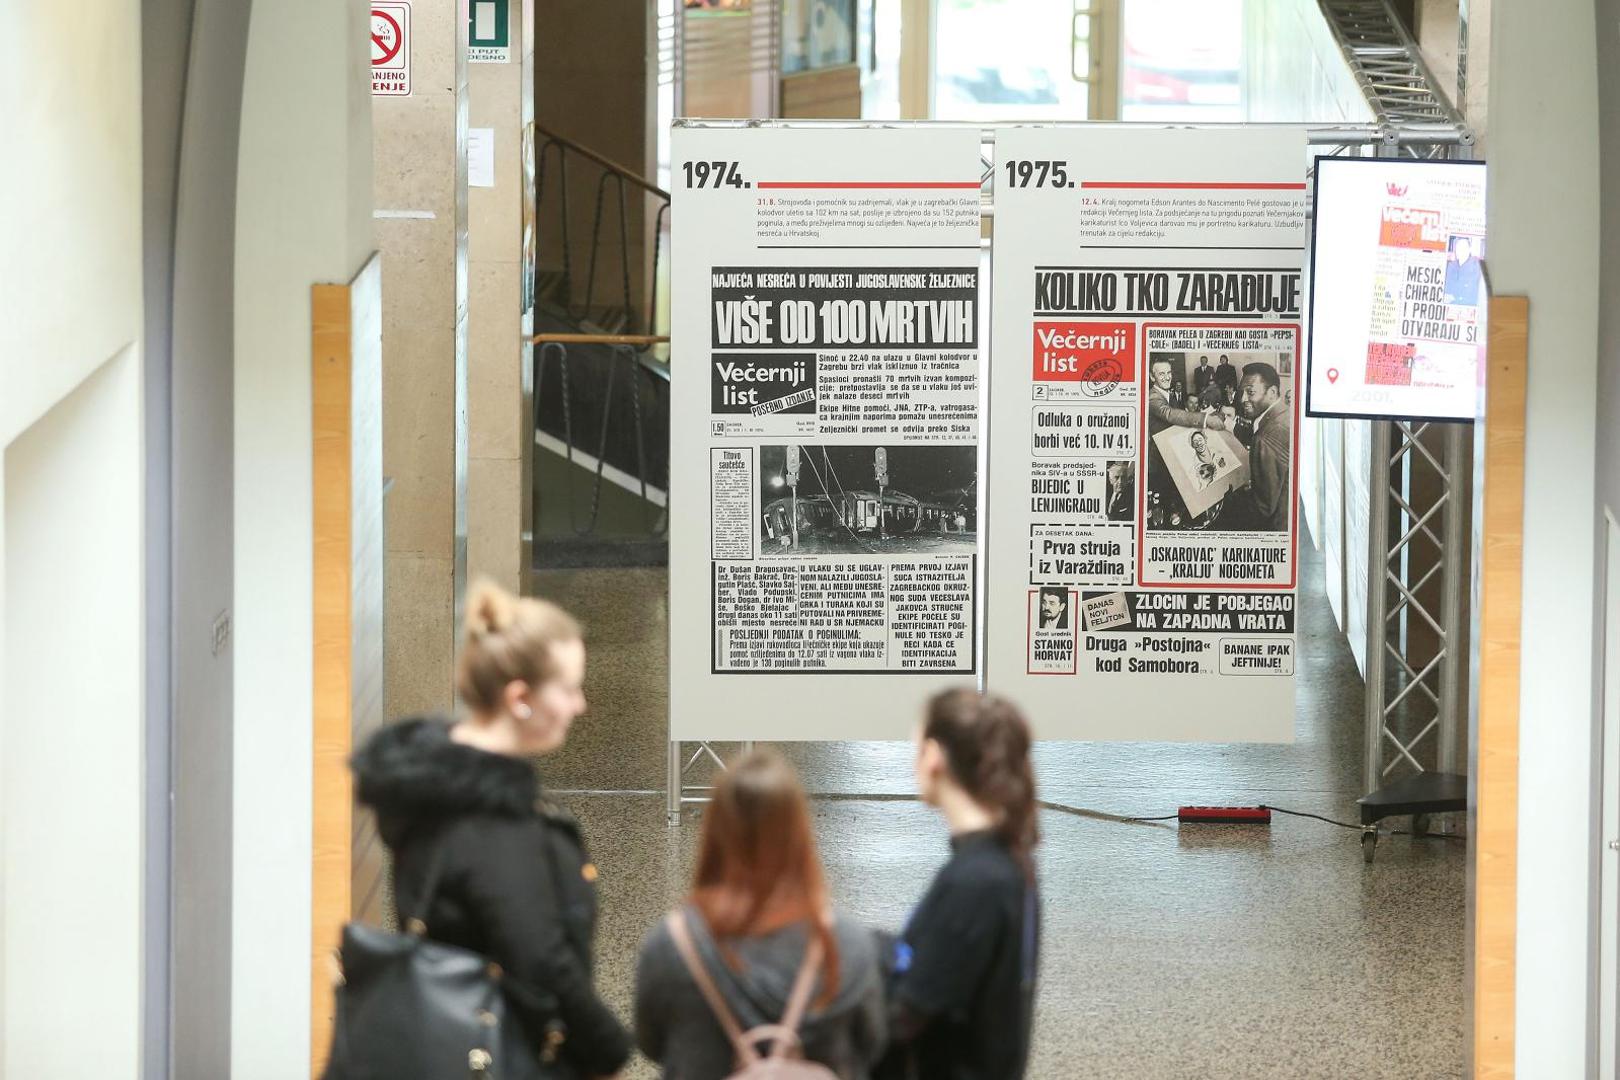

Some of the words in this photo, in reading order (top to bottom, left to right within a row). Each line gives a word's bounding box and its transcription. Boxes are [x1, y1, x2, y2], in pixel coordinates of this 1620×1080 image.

[683, 161, 751, 188] 1974.
[1006, 161, 1074, 188] 1975.
[799, 274, 806, 288] U
[809, 274, 852, 288] POVIJESTI
[856, 274, 926, 288] JUGOSLAVENSKE
[1035, 272, 1117, 311] KOLIKO
[1124, 273, 1169, 312] TKO
[1176, 273, 1300, 315] ZARAĐUJE
[1405, 283, 1444, 303] CHIRAC
[716, 295, 772, 344] VIŠE
[780, 300, 815, 344] OD
[819, 300, 866, 344] 100
[870, 300, 973, 343] MRTVIH
[1403, 302, 1407, 318] I
[1412, 302, 1447, 322] PRODI
[1149, 330, 1176, 339] BORAVAK
[1179, 330, 1197, 338] PELEA
[1199, 330, 1204, 339] U
[1206, 330, 1232, 339] ZAGREBU
[1249, 330, 1268, 339] GOSTA
[1401, 319, 1460, 342] OTVARAJU
[1038, 329, 1126, 355] Večernji
[1043, 352, 1077, 372] list
[716, 361, 805, 388] Večernji
[924, 375, 942, 384] izvan
[723, 385, 759, 406] list
[751, 399, 785, 418] POSEBNO
[785, 389, 815, 411] IZDANJE
[1038, 412, 1072, 427] Odluka
[1077, 415, 1082, 427] o
[1088, 413, 1129, 429] oružanoj
[1034, 433, 1059, 448] borbi
[1063, 434, 1080, 448] već
[1085, 434, 1099, 448] 10.
[1103, 434, 1114, 448] IV
[1117, 434, 1132, 449] 41.
[1032, 462, 1061, 471] Boravak
[1063, 462, 1096, 471] predsjed-
[1077, 480, 1084, 494] U
[1031, 498, 1100, 513] LENJINGRADU
[1044, 540, 1075, 555] Prva
[1080, 540, 1120, 557] struja
[1222, 548, 1286, 563] KARIKATURE
[1039, 559, 1051, 574] iz
[1056, 559, 1124, 575] Varaždina
[1219, 564, 1274, 579] NOGOMETA
[1087, 599, 1114, 611] DANAS
[1193, 595, 1210, 610] JE
[1218, 595, 1292, 611] POBJEGAO
[1089, 609, 1108, 618] NOVI
[1091, 613, 1125, 626] FELJTON
[1136, 613, 1156, 628] NA
[1163, 613, 1231, 629] ZAPADNA
[1238, 614, 1286, 629] VRATA
[1034, 639, 1073, 652] STANKO
[1086, 636, 1127, 653] Druga
[1224, 644, 1262, 655] BANANE
[1267, 645, 1290, 655] IPAK
[1034, 650, 1072, 661] HORVAT
[1232, 657, 1281, 668] JEFTINIJE!
[1096, 657, 1121, 672] kod
[1128, 657, 1199, 674] Samobora
